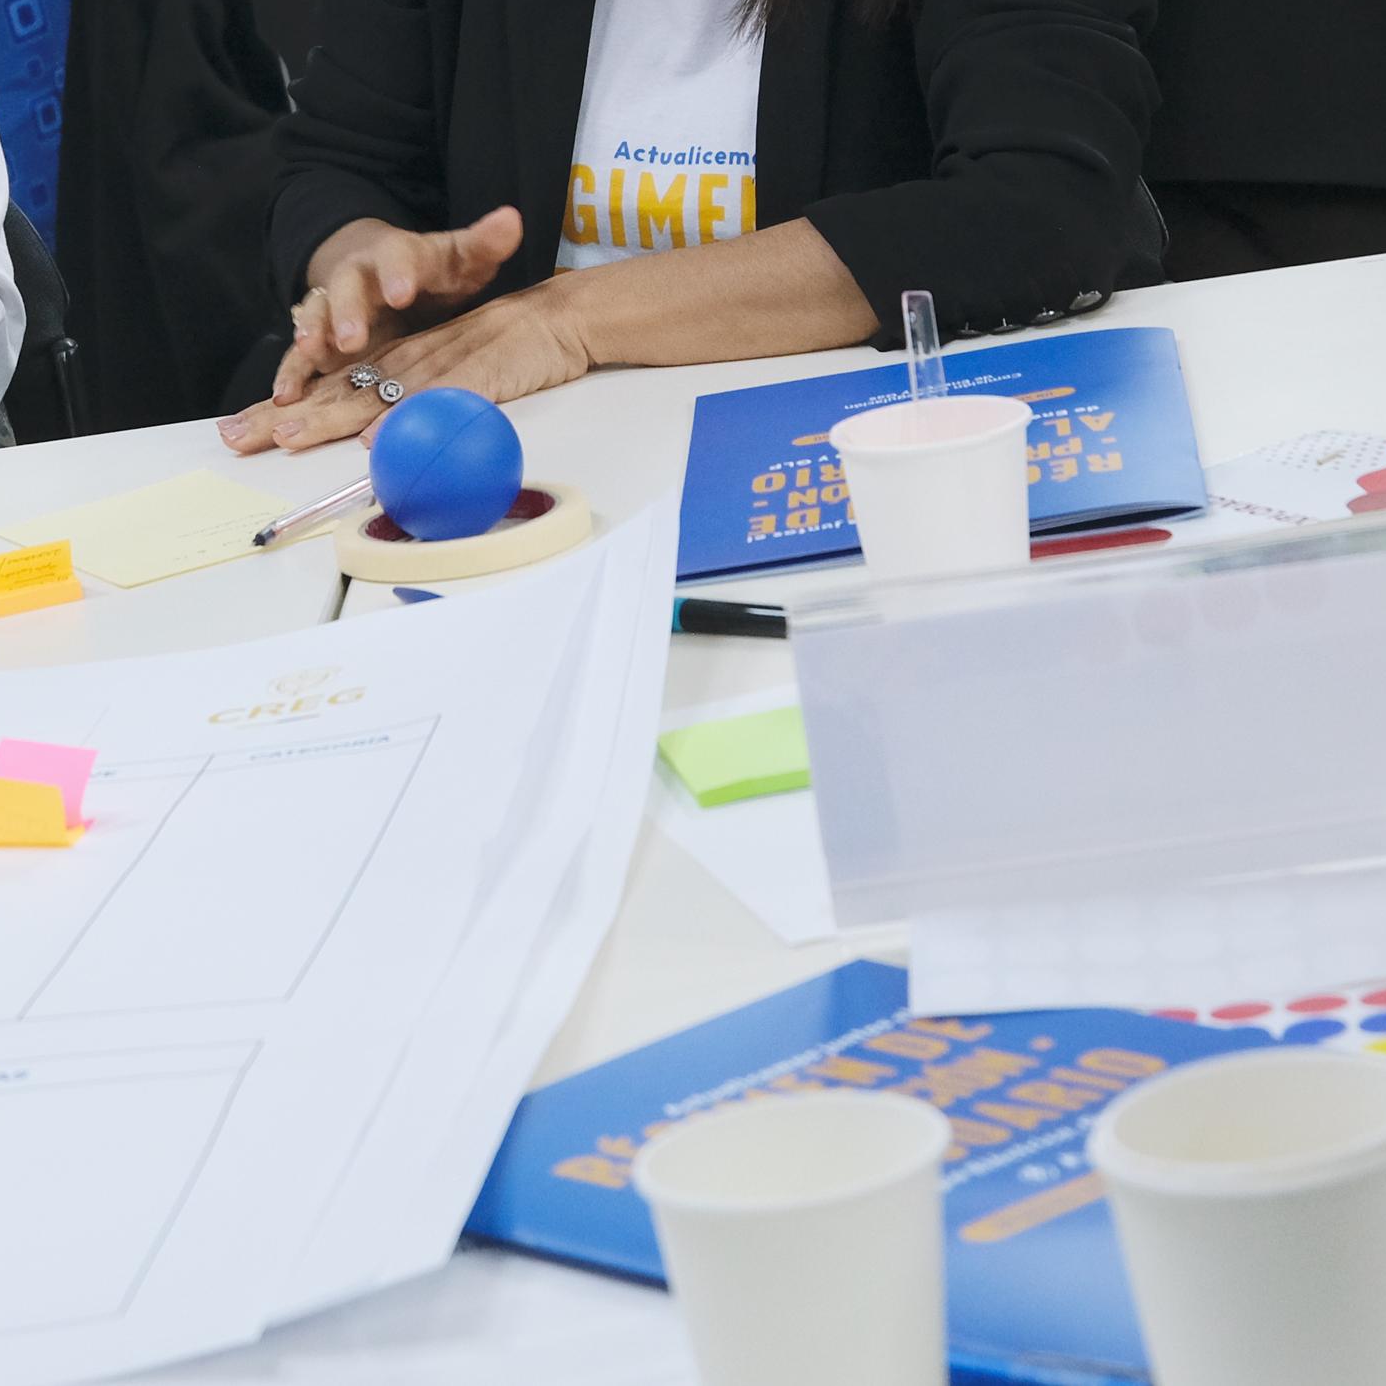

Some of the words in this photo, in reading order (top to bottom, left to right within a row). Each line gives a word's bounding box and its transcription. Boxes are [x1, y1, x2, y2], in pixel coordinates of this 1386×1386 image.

[1042, 411, 1116, 436] AL
[748, 507, 822, 535] DE
[207, 685, 369, 725] CREG
